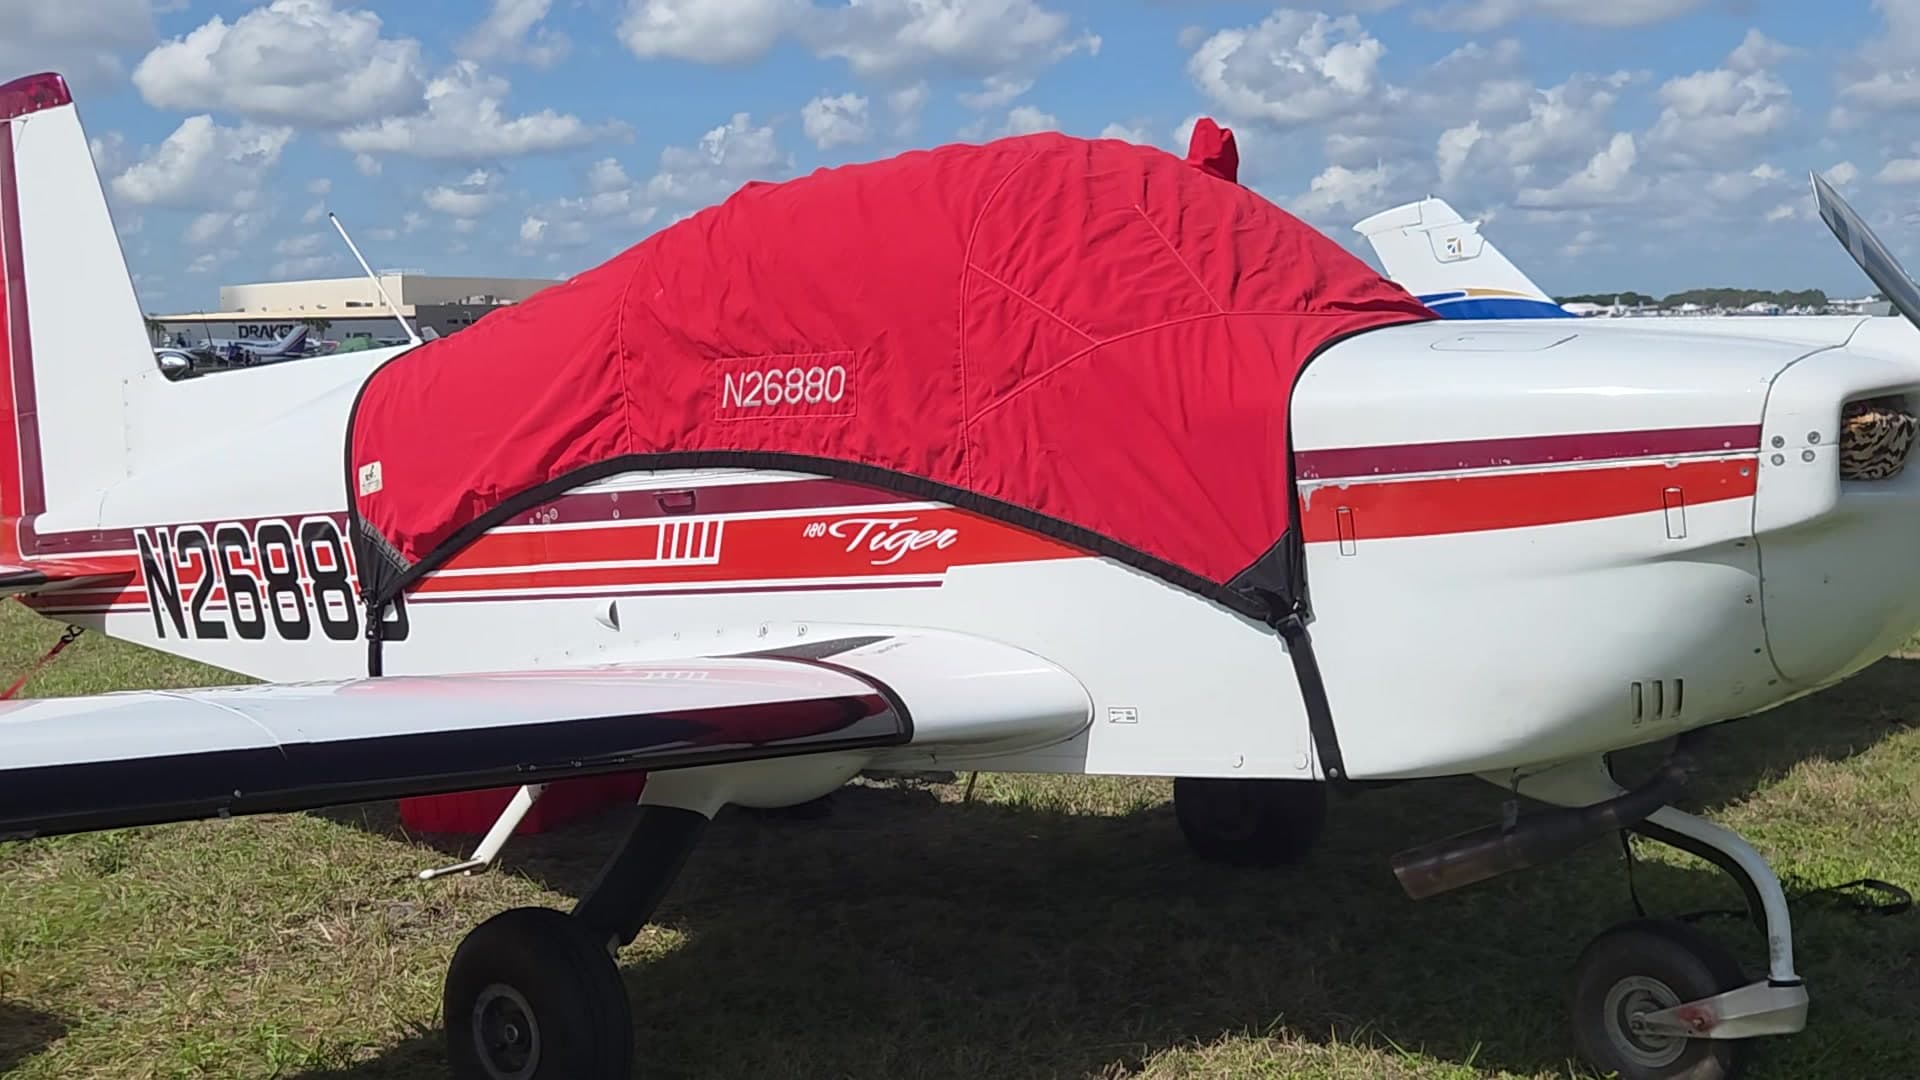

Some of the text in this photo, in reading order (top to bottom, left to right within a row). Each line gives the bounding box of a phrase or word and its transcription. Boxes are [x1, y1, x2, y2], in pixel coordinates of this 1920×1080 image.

[238, 324, 295, 339] DRAKE
[721, 365, 846, 408] N26880
[803, 517, 958, 565] 180 Tiger
